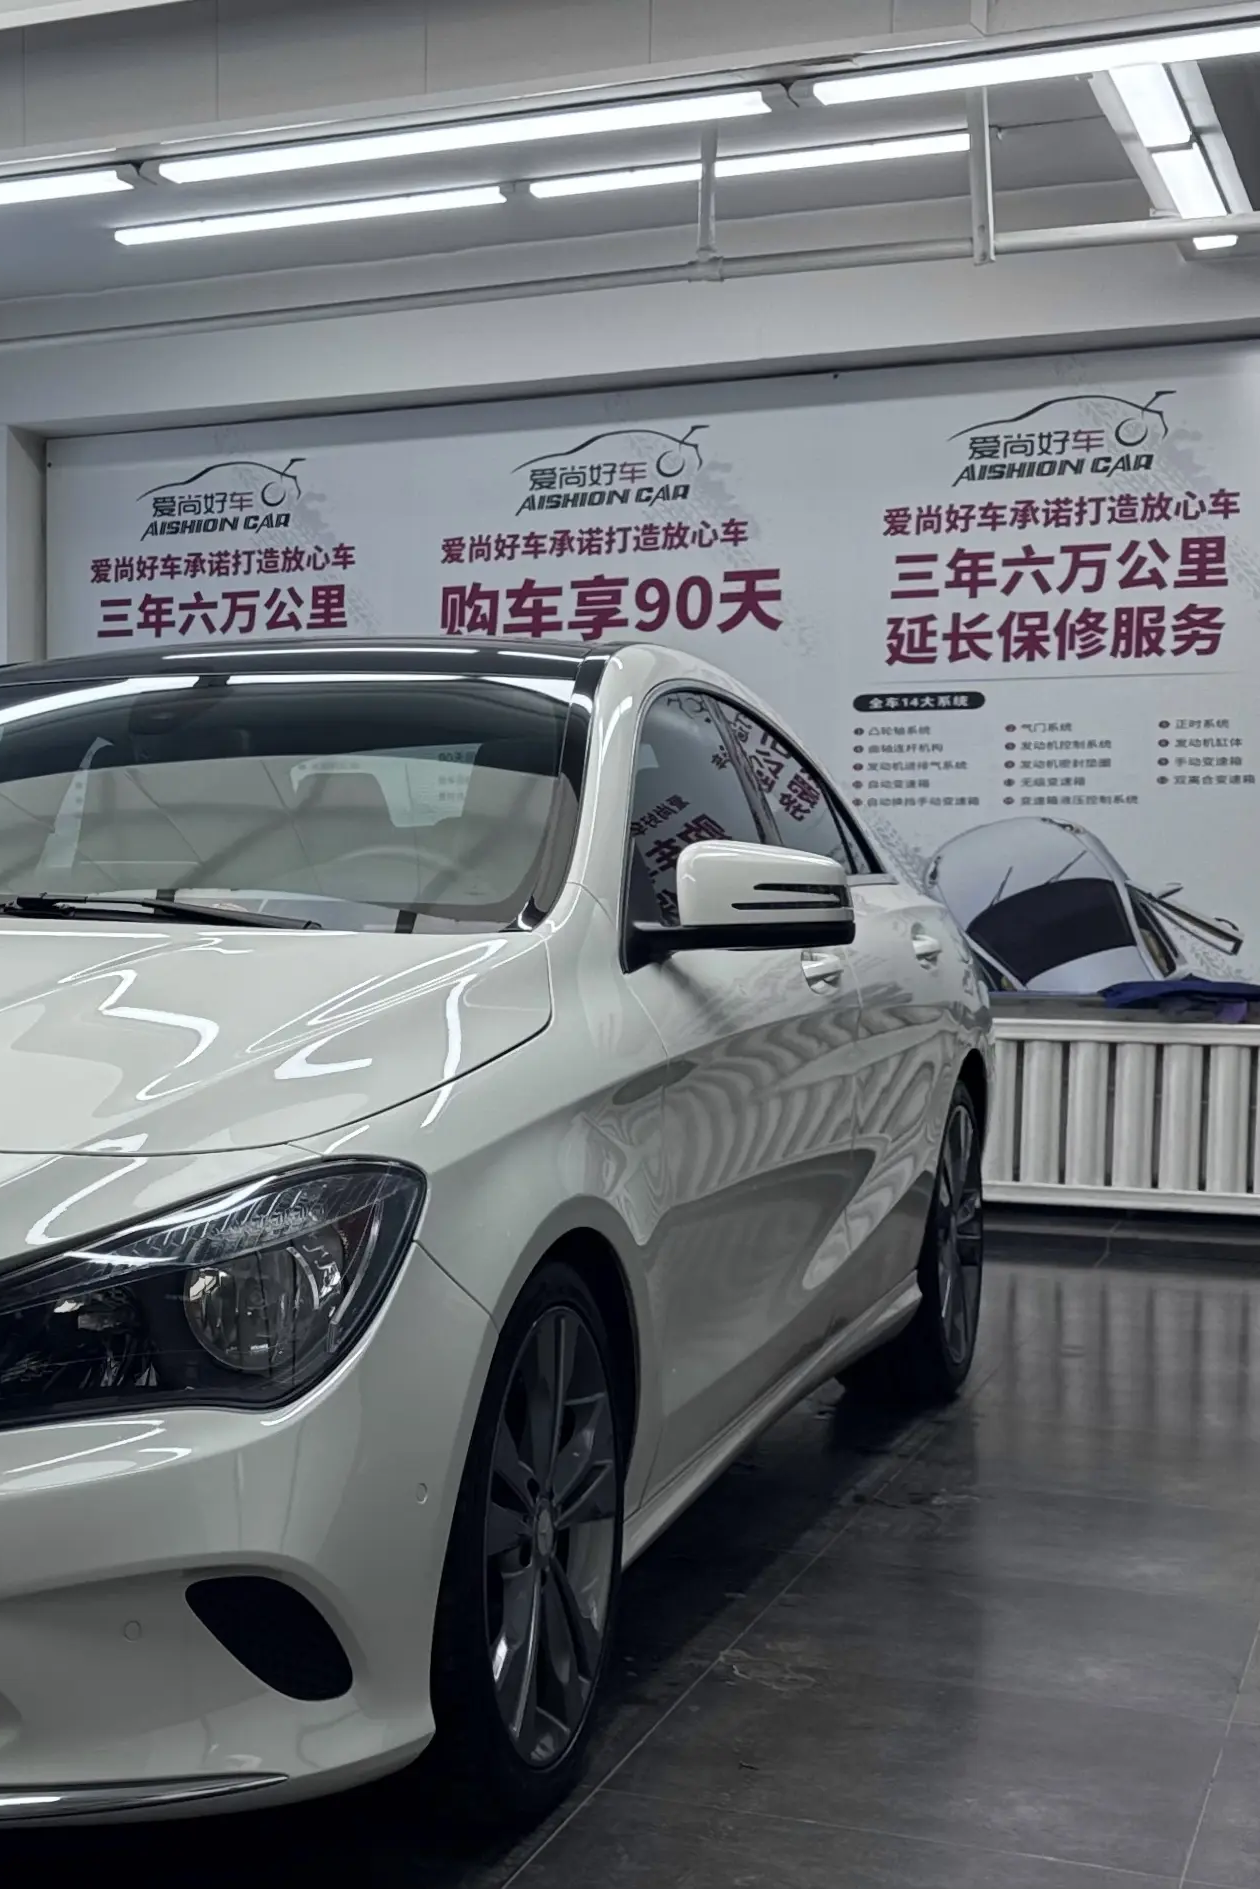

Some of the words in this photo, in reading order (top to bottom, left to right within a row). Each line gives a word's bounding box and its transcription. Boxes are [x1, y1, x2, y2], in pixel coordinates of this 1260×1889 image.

[968, 429, 1105, 461] 爱尚好车
[529, 461, 647, 492] 爱尚好车
[952, 458, 1086, 487] AISHION
[1090, 453, 1154, 478] CAR
[151, 491, 255, 518] 爱尚好车
[515, 489, 629, 516] AISHION
[634, 483, 691, 507] CAR
[882, 488, 1241, 537] 爱尚好车承诺打造放心车
[140, 516, 239, 541] AISHION
[242, 512, 292, 533] CAR
[440, 518, 749, 564] 爱尚好车承诺打造放心车
[90, 542, 356, 584] 爱尚好车承诺打造放心车
[890, 535, 1229, 600] 三年六万公里
[96, 583, 348, 639] 三年六万公里
[440, 567, 784, 641] 购车享90天
[885, 603, 1226, 667] 延长保修服务
[868, 695, 969, 710] 全车14大系统
